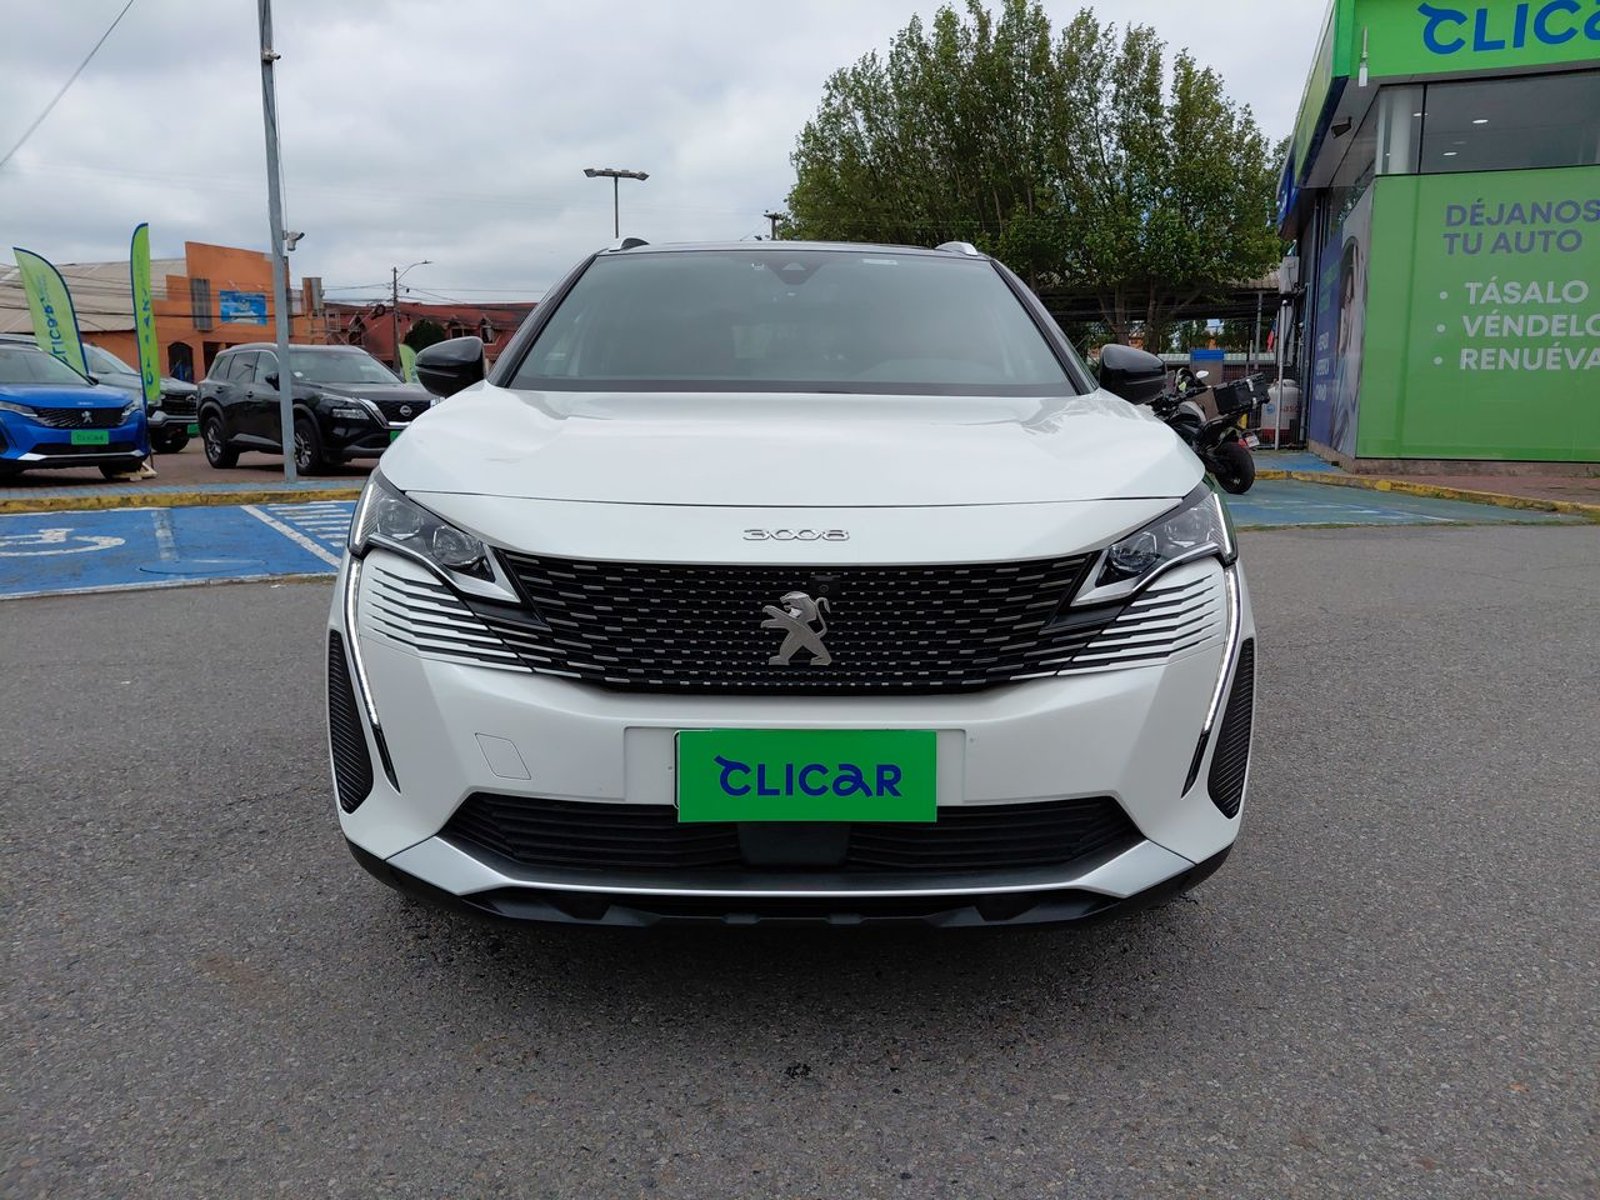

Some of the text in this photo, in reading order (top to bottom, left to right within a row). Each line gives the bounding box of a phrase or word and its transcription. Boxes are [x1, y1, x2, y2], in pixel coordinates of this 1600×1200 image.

[1446, 198, 1600, 227] DÉJANOS
[1443, 229, 1582, 255] TU AUTO
[1464, 275, 1589, 305] TÁSALO
[743, 529, 849, 541] 3008
